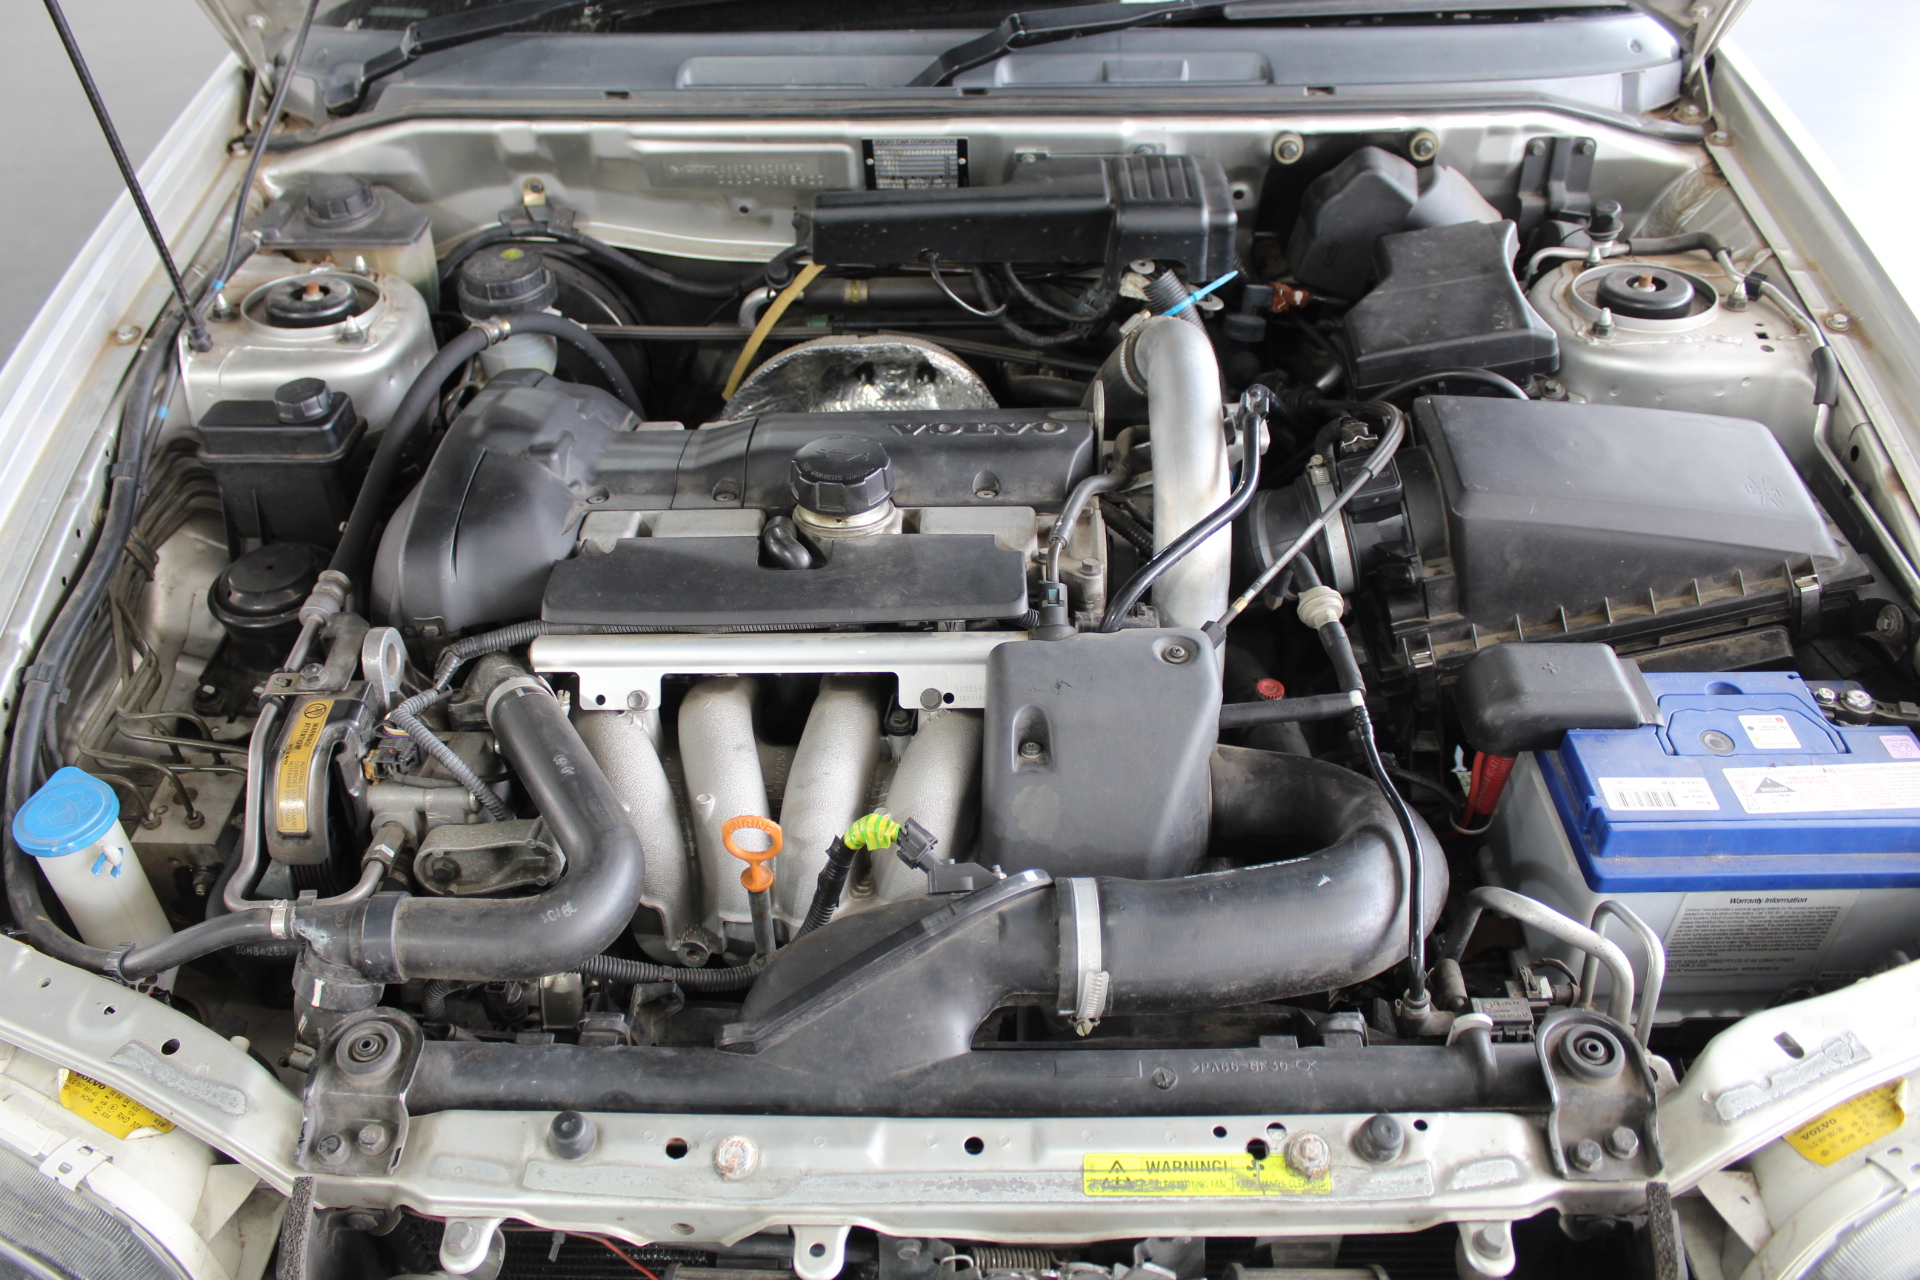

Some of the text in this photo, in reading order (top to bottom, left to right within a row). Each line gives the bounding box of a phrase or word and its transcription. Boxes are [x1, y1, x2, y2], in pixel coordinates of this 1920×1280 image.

[886, 422, 1068, 436] VOLVO
[304, 722, 319, 748] WARNING!
[727, 819, 774, 834] ENGINE
[76, 1072, 106, 1090] VOLVO
[1801, 1118, 1837, 1140] VOLVO
[1145, 1160, 1228, 1173] WARNING!
